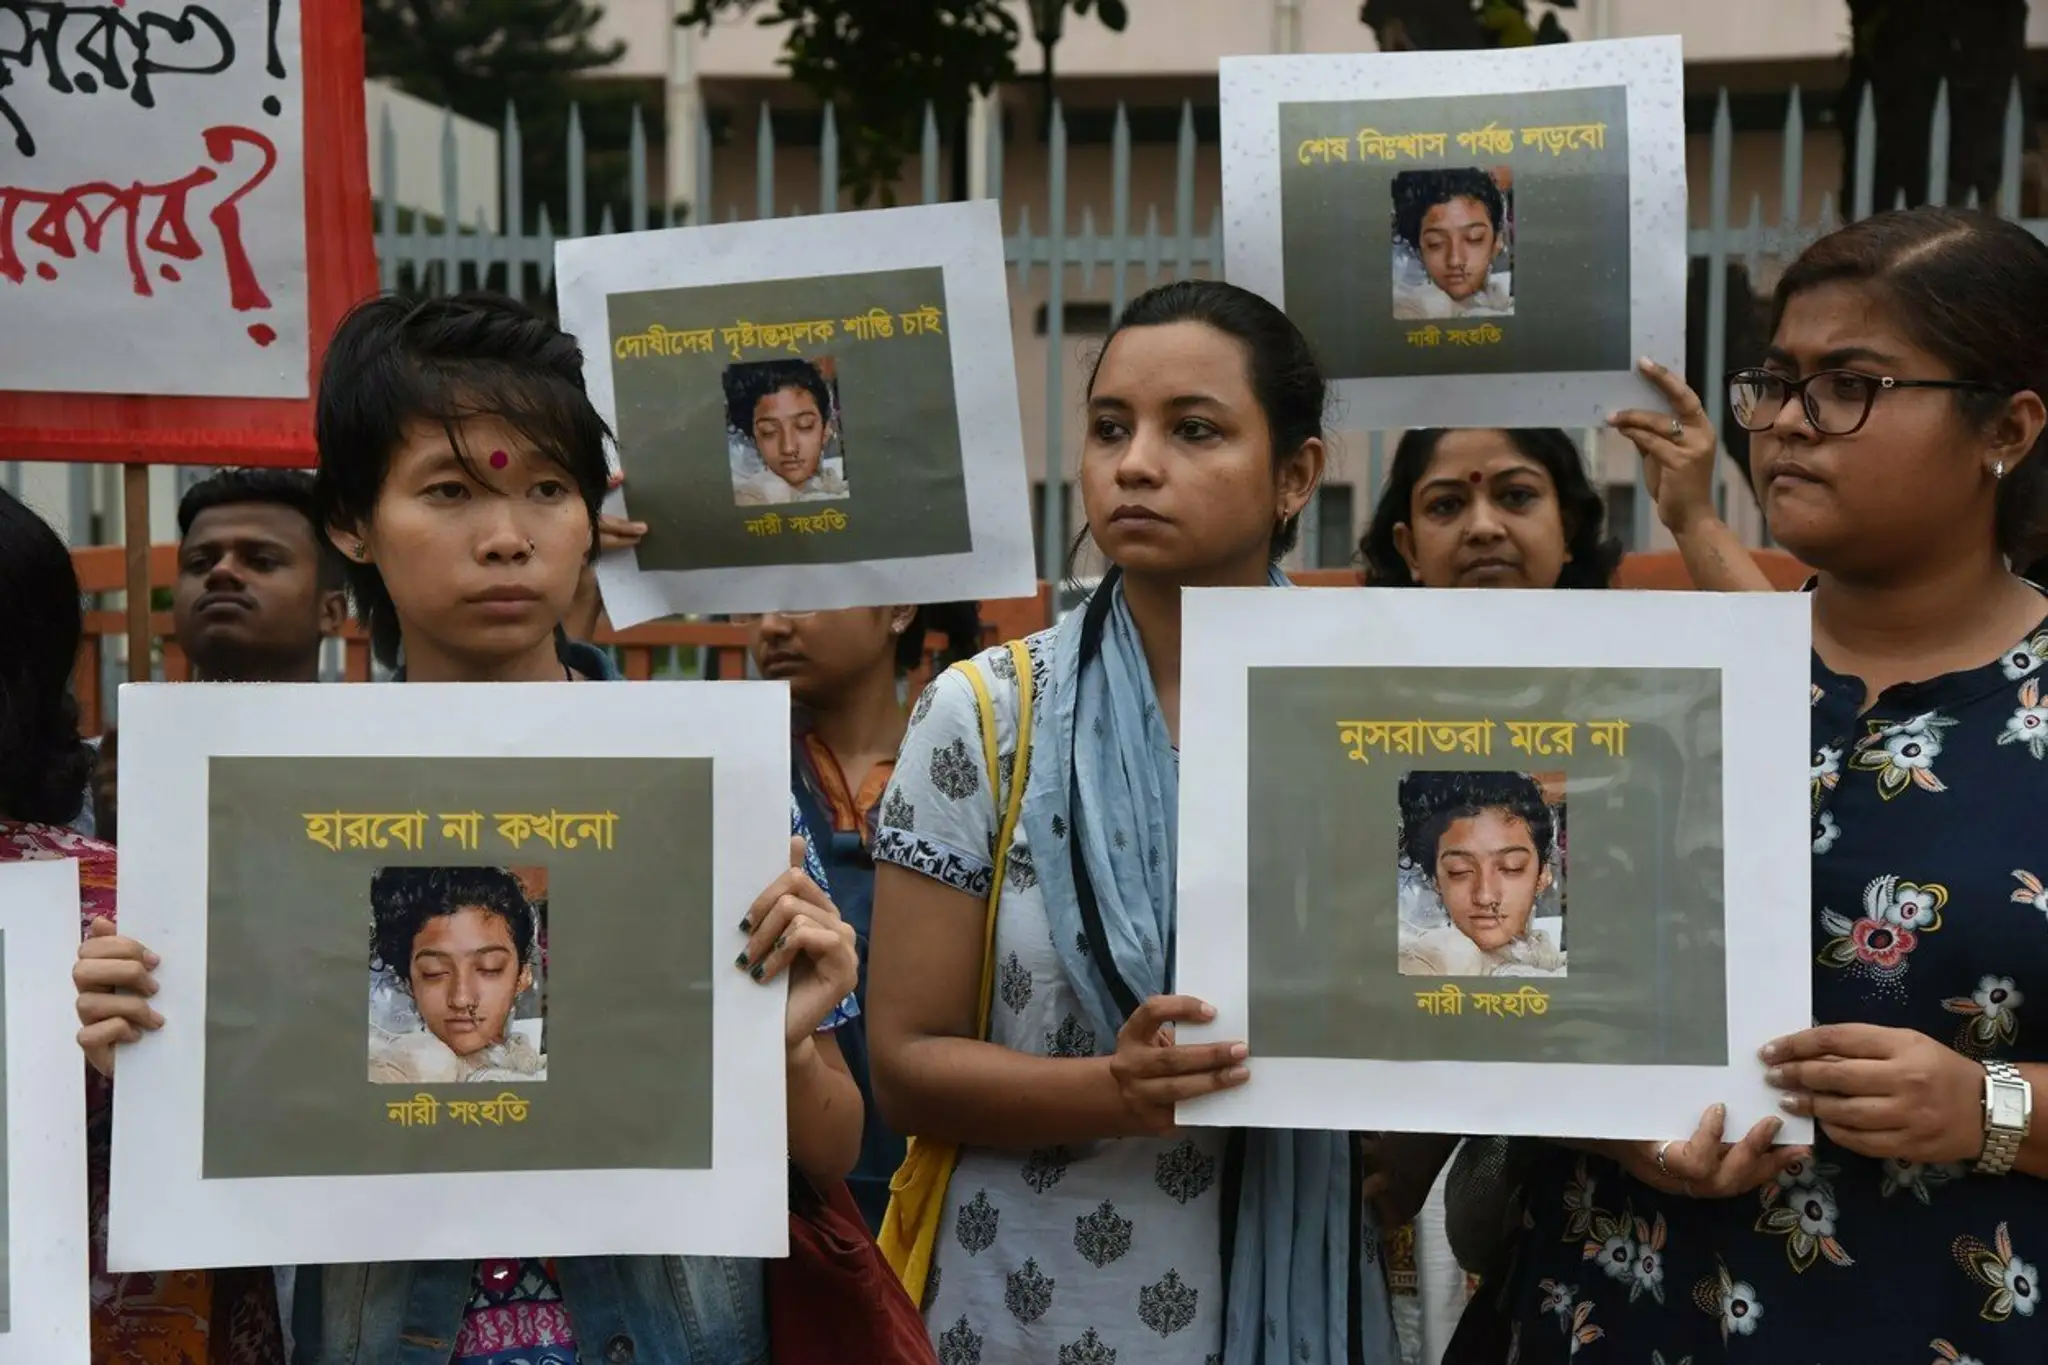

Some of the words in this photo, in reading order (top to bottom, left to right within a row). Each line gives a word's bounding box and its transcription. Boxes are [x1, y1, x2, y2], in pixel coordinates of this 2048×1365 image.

[1297, 135, 1350, 166] শেষ
[1455, 121, 1515, 156] পর্যন্ত
[1520, 122, 1607, 157] লড়বো
[614, 323, 715, 361] দোষীদের
[721, 318, 834, 360] দৃষ্টান্তমূলক
[842, 306, 894, 341] শাস্তি
[900, 305, 943, 336] চাই
[1405, 324, 1441, 348] নারী
[1446, 323, 1503, 347] সংহতি
[745, 512, 782, 536] নারী
[788, 508, 849, 534] সংহতি
[1336, 718, 1496, 764] নুসরাতরা
[1506, 719, 1578, 757] মরে
[1586, 718, 1631, 757] না
[302, 809, 429, 851] হারবো
[439, 810, 485, 850] না
[494, 808, 620, 851] কখনো
[1414, 983, 1465, 1016] নারী
[1472, 985, 1549, 1018] সংহতি
[387, 1093, 440, 1127] নারী
[448, 1092, 529, 1127] সংহতি
